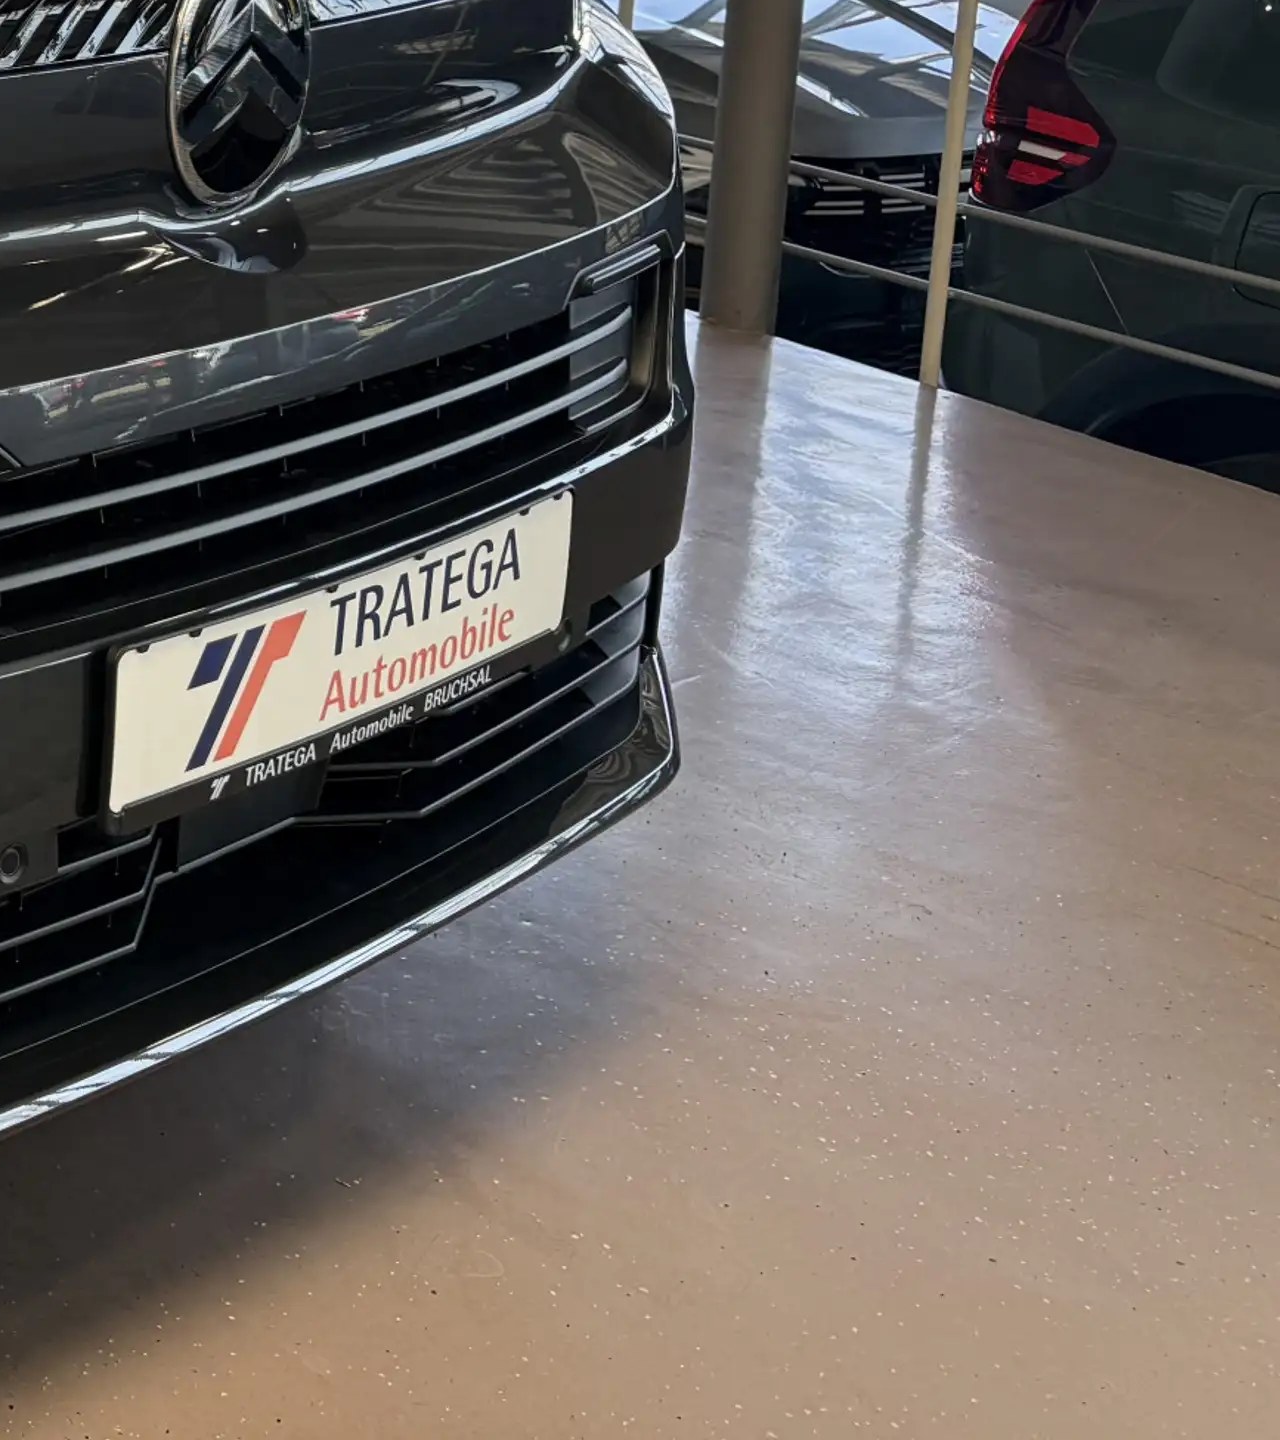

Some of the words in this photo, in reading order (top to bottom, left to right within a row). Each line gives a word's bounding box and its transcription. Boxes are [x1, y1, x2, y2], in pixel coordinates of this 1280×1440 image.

[330, 528, 521, 656] TRATEGA
[319, 603, 515, 722] Automobile
[245, 745, 316, 787] TRATEGA
[330, 703, 414, 753] Automobile
[424, 665, 492, 712] BRUCHSAL
